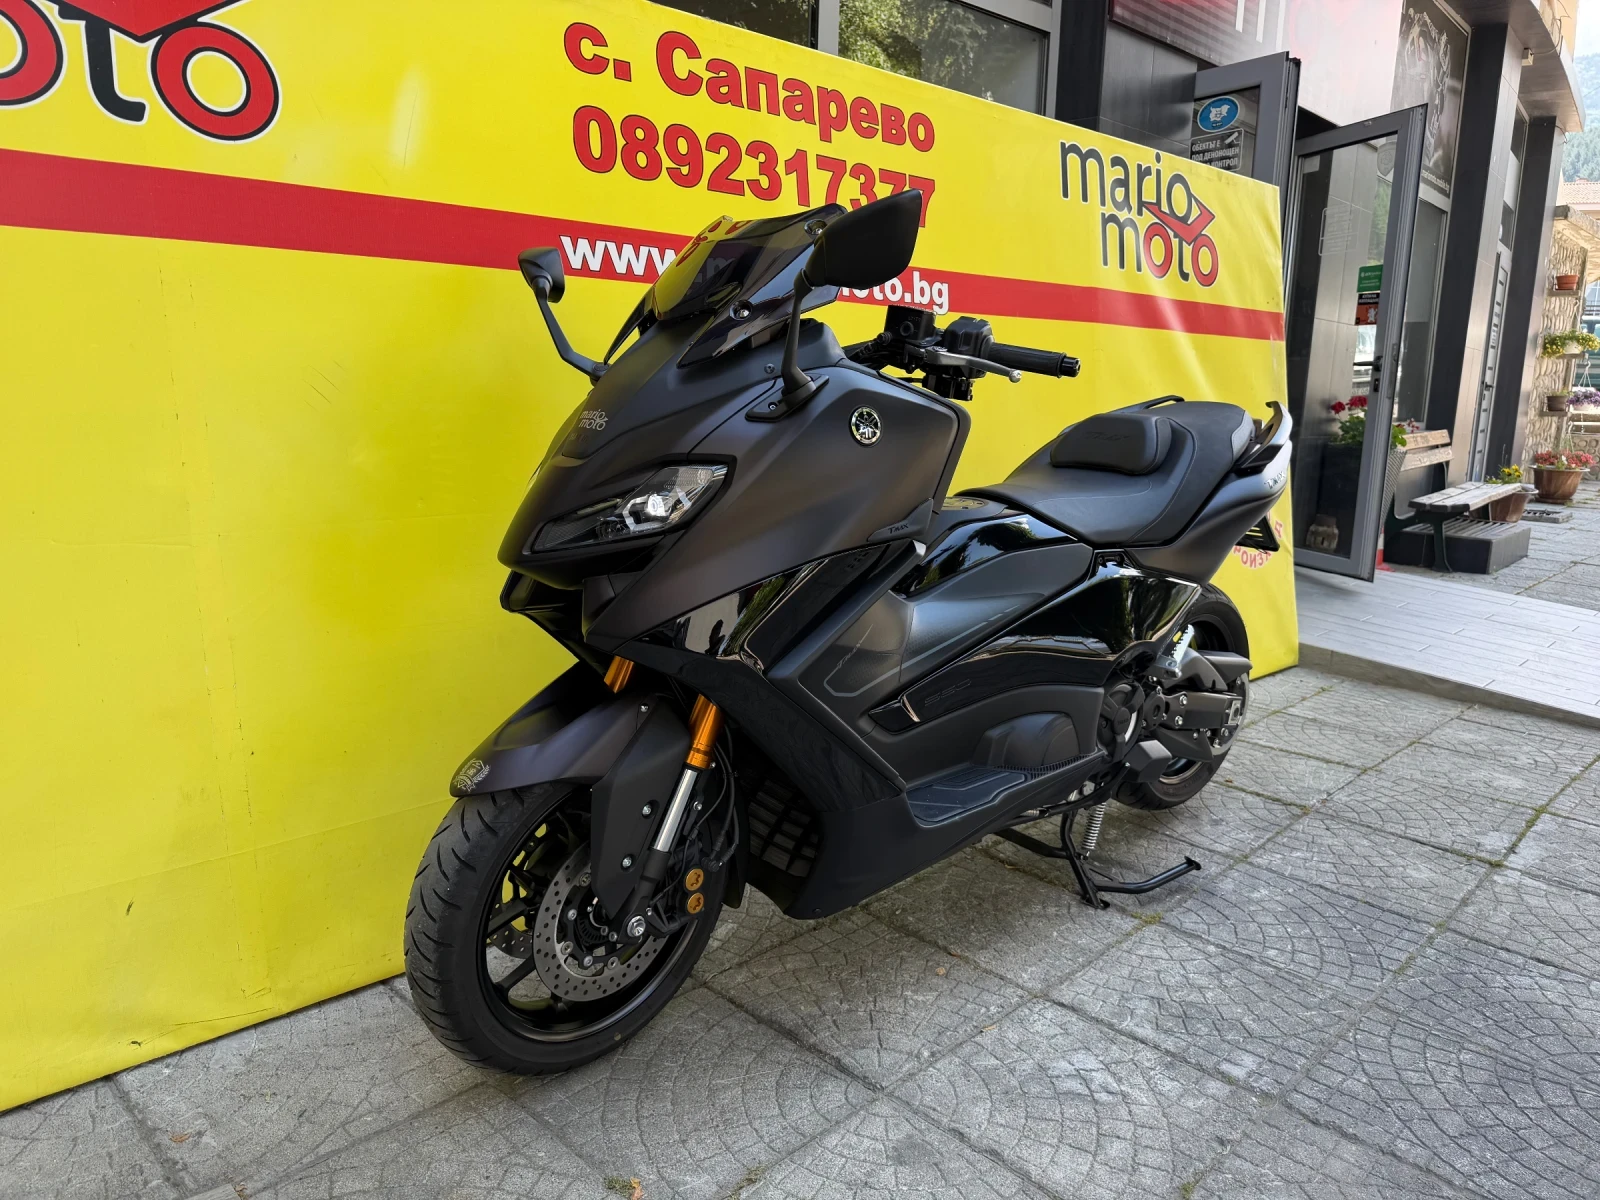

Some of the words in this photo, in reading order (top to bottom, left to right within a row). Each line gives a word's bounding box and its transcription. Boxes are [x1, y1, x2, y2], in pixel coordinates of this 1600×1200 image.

[564, 22, 632, 82] с.
[656, 31, 935, 152] Сапарево
[1060, 141, 1193, 224] mario
[1100, 211, 1219, 287] moto
[578, 418, 606, 431] moto
[579, 408, 606, 420] mario
